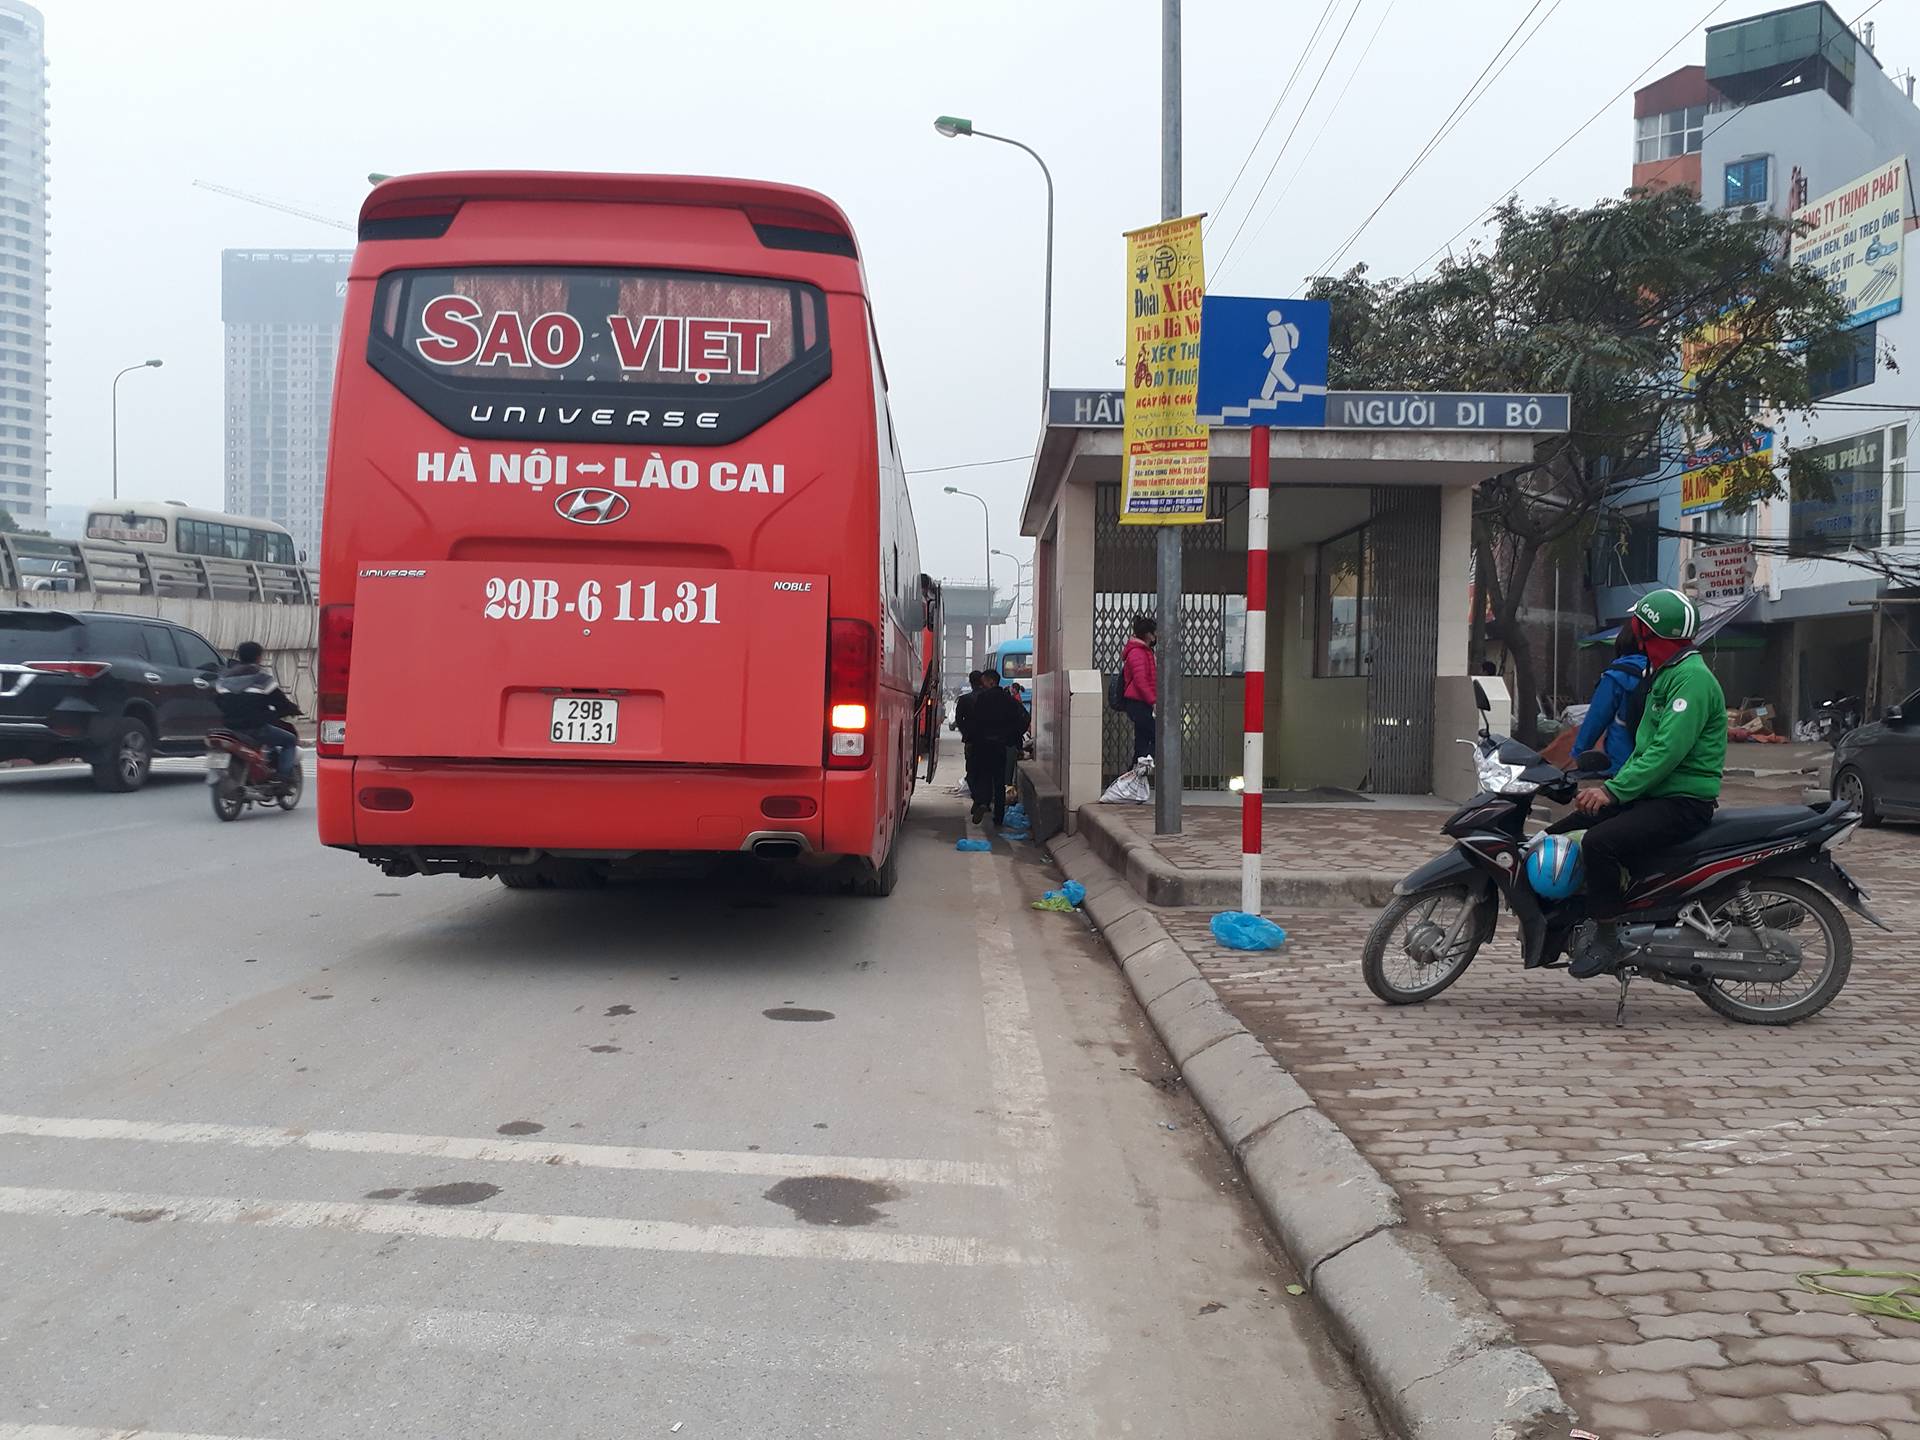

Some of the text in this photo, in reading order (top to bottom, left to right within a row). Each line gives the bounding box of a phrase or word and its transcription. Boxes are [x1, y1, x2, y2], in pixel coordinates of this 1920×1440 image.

[1824, 200, 1836, 225] TY
[1872, 163, 1901, 202] PHÁT
[1859, 219, 1880, 241] TREO
[1162, 274, 1203, 313] Xiếc
[416, 294, 771, 384] SAO VIỆT
[1164, 315, 1182, 339] Hà
[1184, 313, 1200, 340] Nộ
[470, 405, 720, 429] UNIVERSE
[1343, 396, 1435, 426] NGƯỜI
[1456, 402, 1484, 426] ĐI
[1506, 397, 1542, 429] BỘ
[1839, 439, 1877, 470] PHÁT
[416, 446, 785, 494] HÀ NỘI LÀO CAI
[773, 581, 812, 592] NOBLE
[613, 580, 721, 624] 11.31
[1641, 603, 1660, 624] Grab
[568, 701, 603, 720] 29B
[553, 721, 613, 741] 611.31
